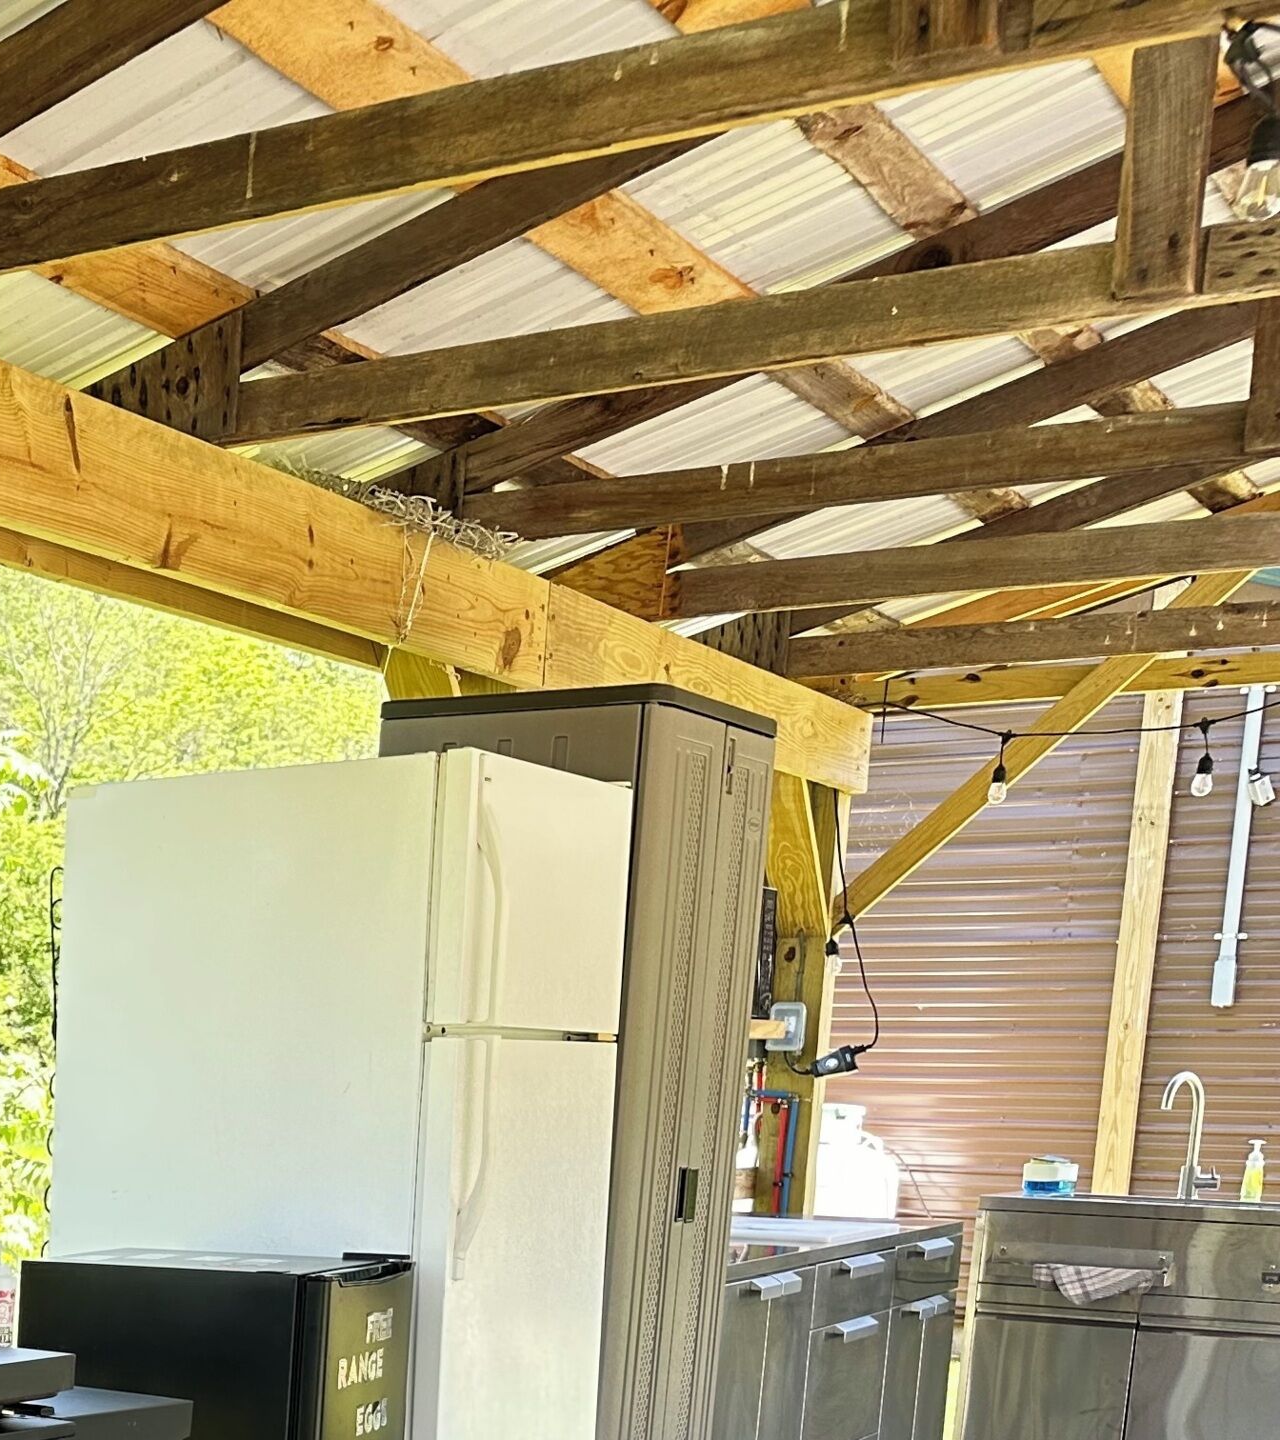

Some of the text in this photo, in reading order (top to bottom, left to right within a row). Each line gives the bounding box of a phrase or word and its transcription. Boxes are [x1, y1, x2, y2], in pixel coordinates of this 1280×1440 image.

[366, 1307, 394, 1344] FREE
[337, 1347, 384, 1390] RANGE
[356, 1397, 388, 1437] EGGS
